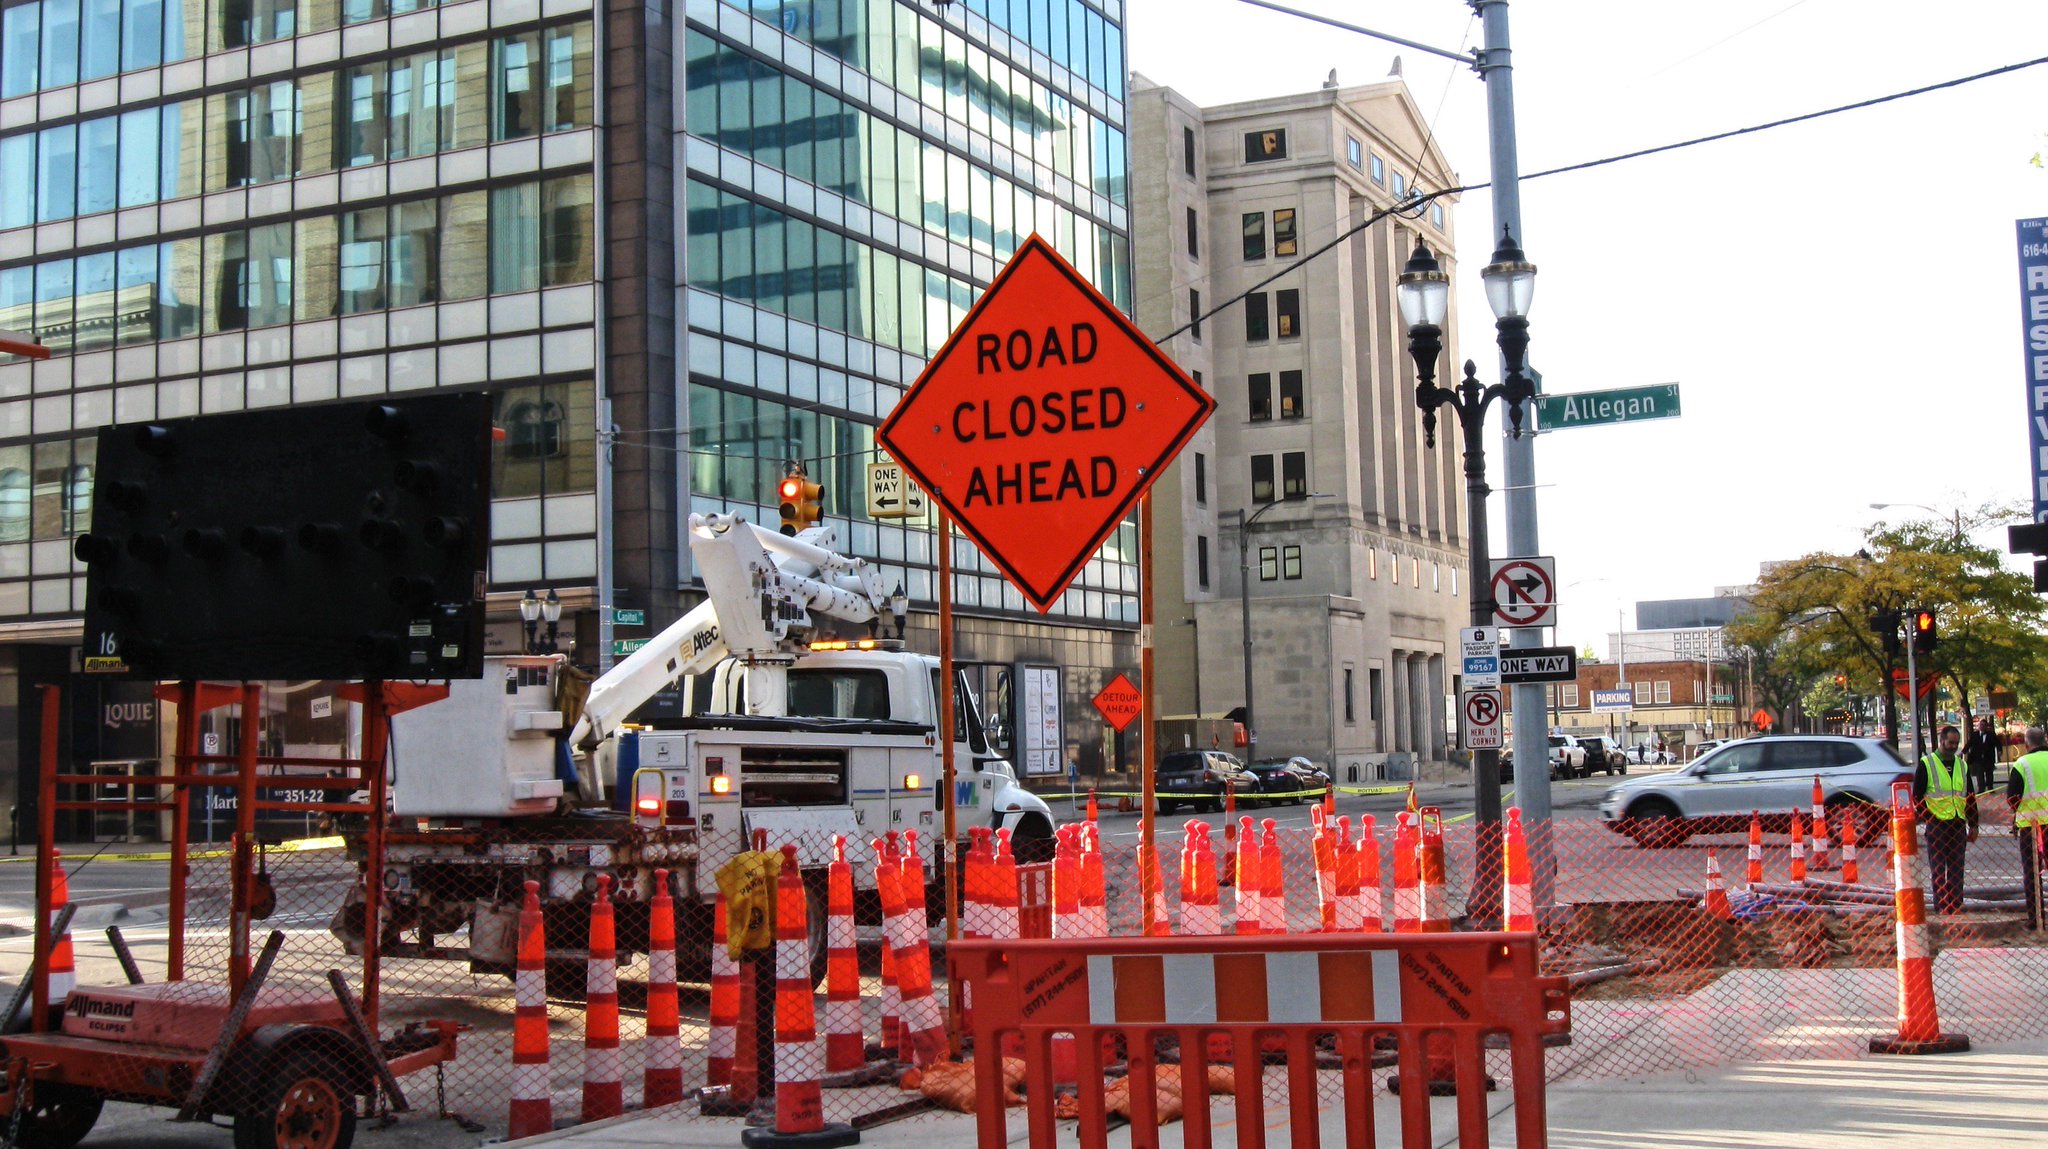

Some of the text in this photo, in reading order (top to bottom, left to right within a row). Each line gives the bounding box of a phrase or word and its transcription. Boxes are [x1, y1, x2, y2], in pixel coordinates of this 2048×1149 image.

[976, 322, 1098, 375] ROAD
[1538, 385, 1678, 422] W Allegan St
[952, 387, 1127, 443] CLOSED
[875, 469, 897, 480] ONE
[874, 481, 899, 493] WAY
[963, 456, 1117, 508] AHEAD
[617, 610, 638, 623] Capitol
[100, 631, 116, 655] 16
[693, 625, 719, 656] Altec
[86, 658, 126, 671] Allman
[1468, 663, 1493, 672] 99167
[1500, 657, 1565, 673] ONE WAY
[1102, 692, 1138, 702] DETOUR
[1596, 692, 1630, 703] PARKING
[313, 701, 329, 713] LOUIE
[1105, 704, 1136, 713] AHEAD
[105, 703, 154, 728] LOUIE
[1471, 727, 1498, 736] HERE TO
[1472, 737, 1496, 745] CORNER
[284, 789, 324, 803] 351-22
[671, 789, 686, 798] 203
[206, 794, 238, 810] Mart
[67, 995, 136, 1018] Allmand
[89, 1021, 126, 1033] ECLIPSE
